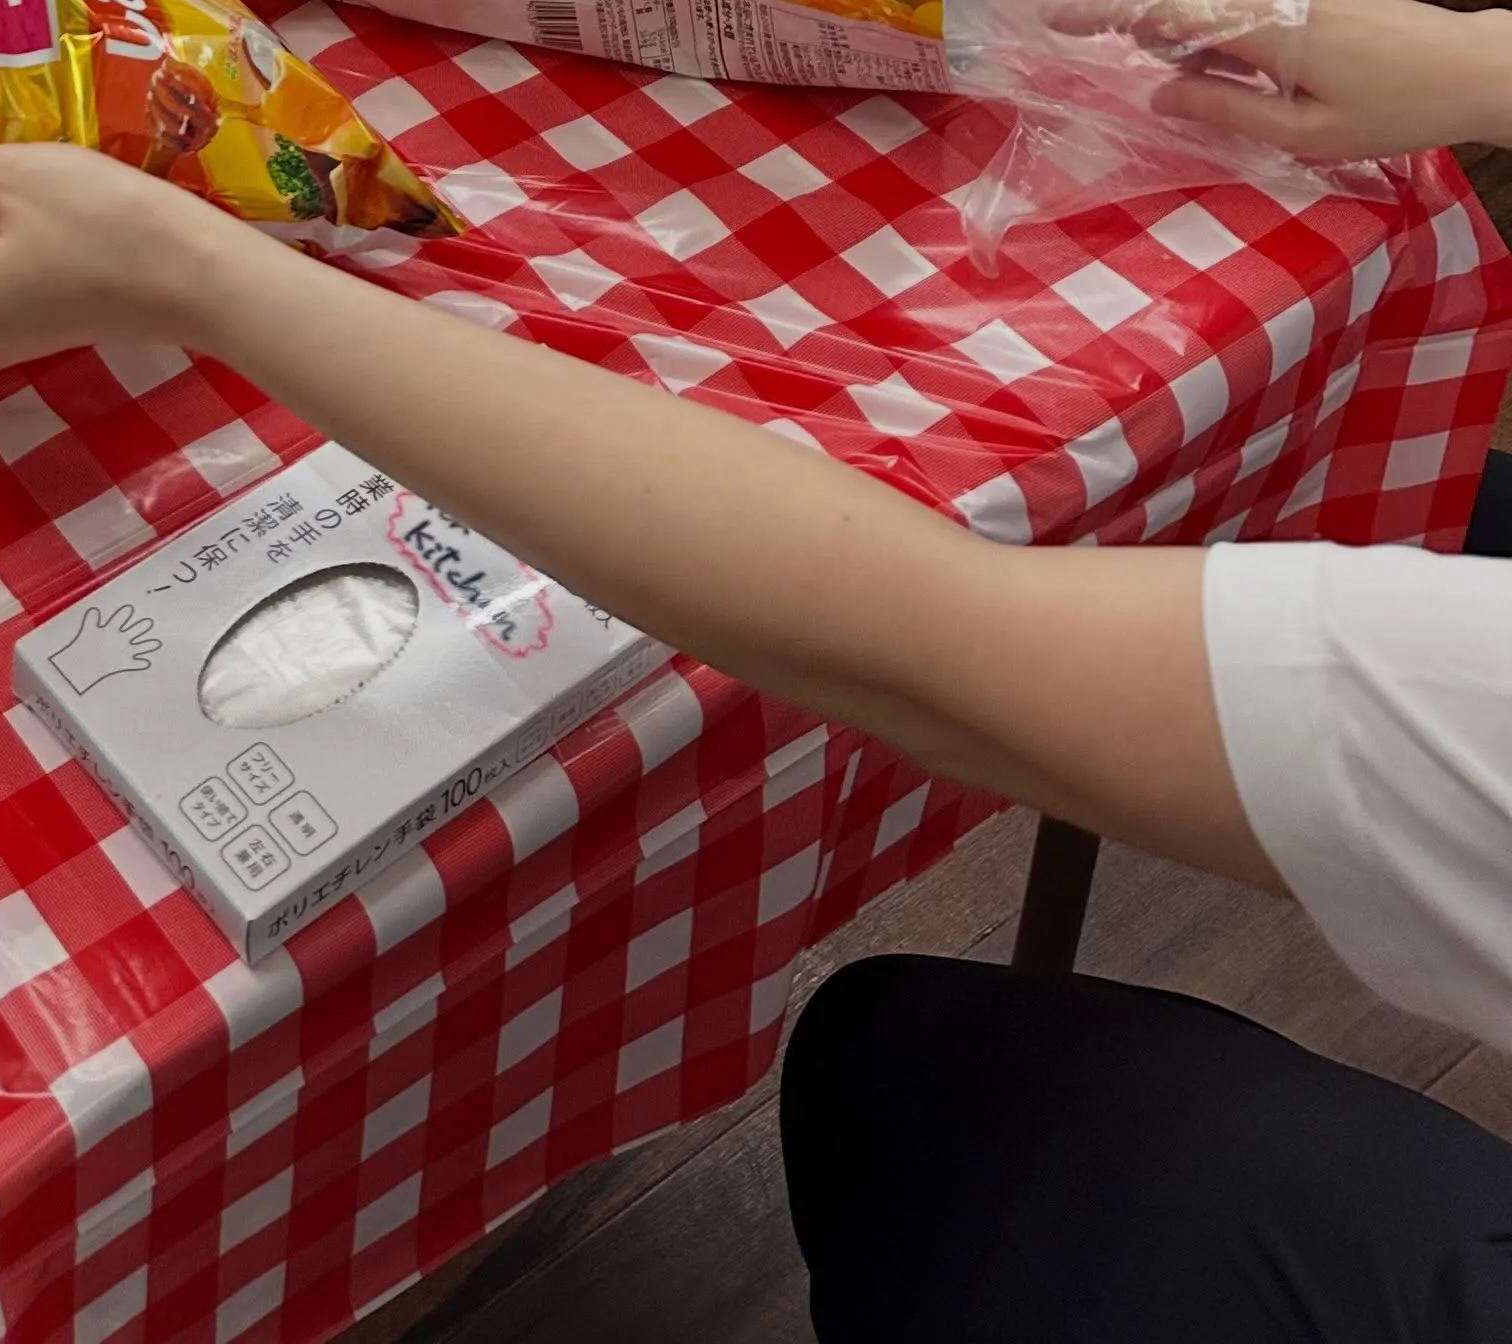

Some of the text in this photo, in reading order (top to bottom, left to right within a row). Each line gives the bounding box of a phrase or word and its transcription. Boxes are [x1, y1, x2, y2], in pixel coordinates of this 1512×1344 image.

[240, 761, 271, 793] サイズ
[252, 751, 280, 783] フリー
[248, 838, 276, 867] 左右
